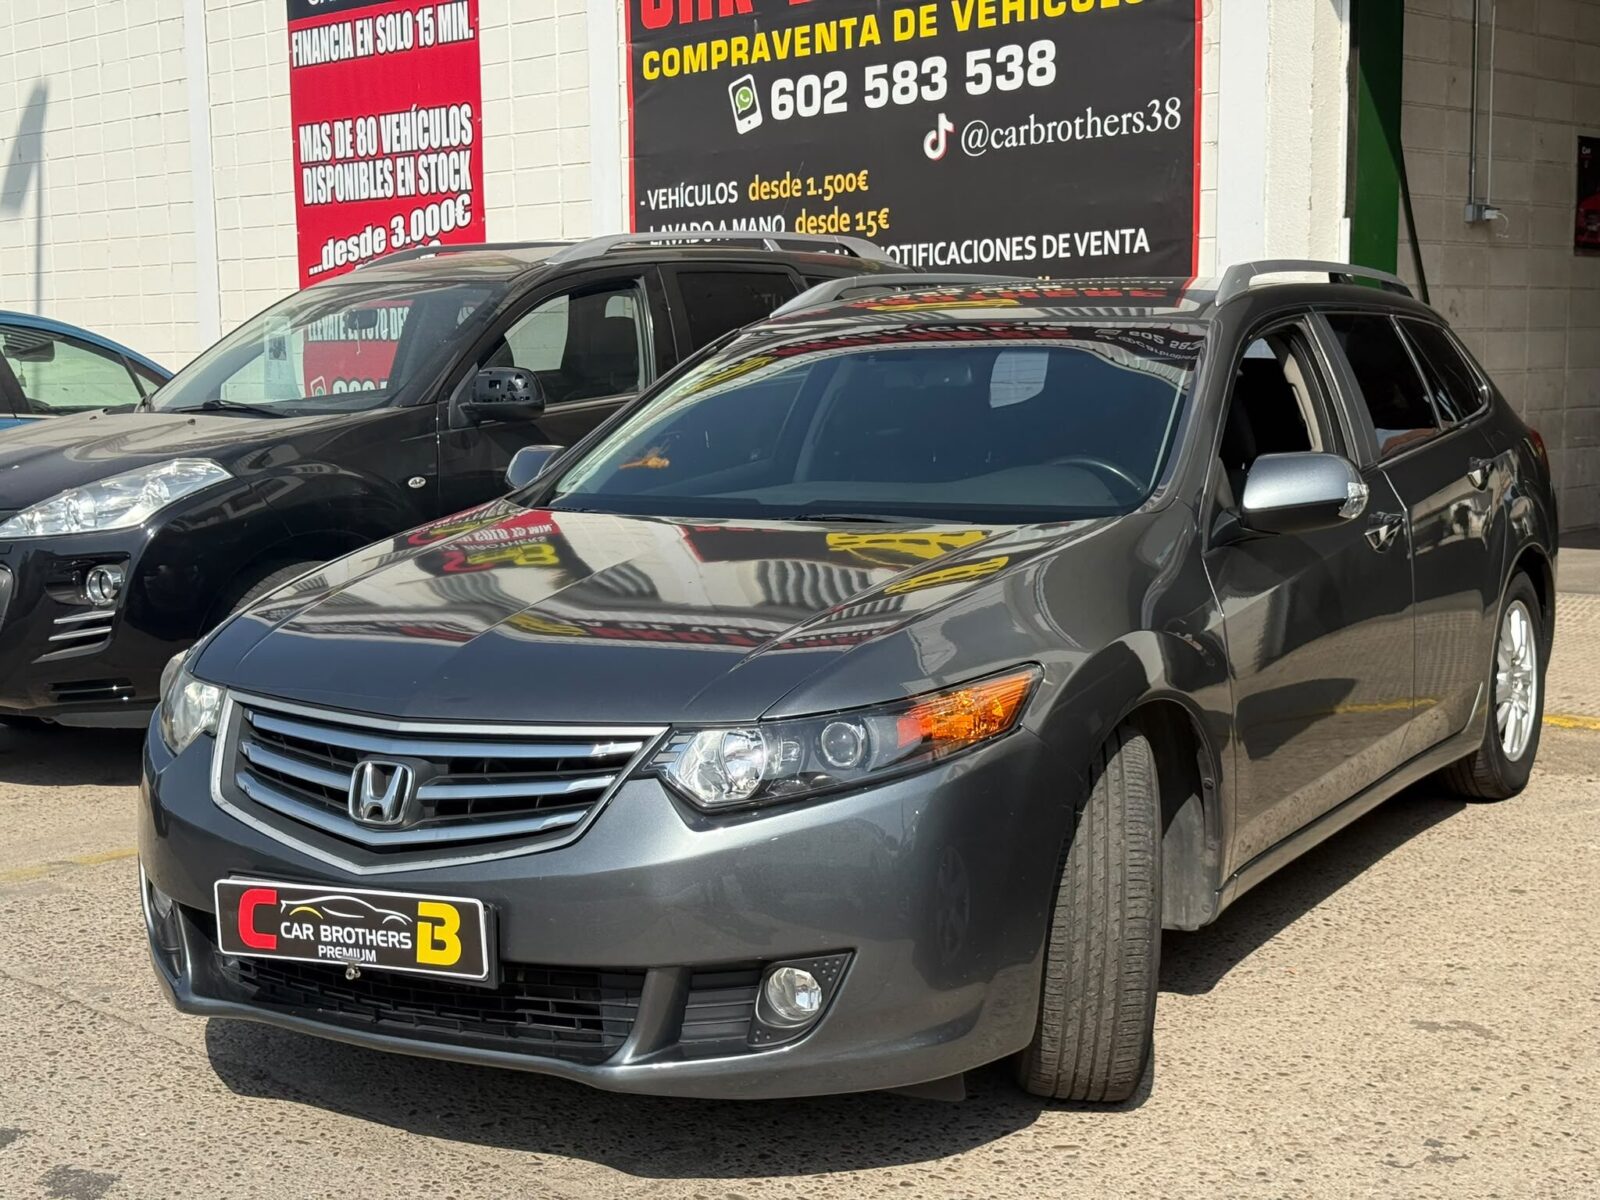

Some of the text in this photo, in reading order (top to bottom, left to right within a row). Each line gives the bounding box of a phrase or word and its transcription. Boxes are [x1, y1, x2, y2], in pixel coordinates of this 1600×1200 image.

[291, 1, 474, 68] FINANCIA EN SOLO 15 MIN.
[642, 14, 881, 80] COMPRAVENTA
[893, 3, 938, 42] DE
[771, 39, 1057, 120] 602 583 538
[299, 104, 473, 163] MAS DE 80 VEHÍCULOS
[961, 97, 1182, 157] @carbrothers38
[302, 150, 472, 205] DISPONIBLES EN STOCK
[749, 171, 802, 201] desde
[806, 170, 869, 201] 1.500€
[390, 193, 472, 249] 3.000€
[795, 206, 850, 234] desde
[855, 208, 890, 237] 15€
[1042, 233, 1071, 258] DE
[1074, 228, 1150, 256] VENTA
[238, 888, 278, 950] C
[280, 921, 412, 949] CAR BROTHERS
[416, 901, 462, 966] B
[318, 944, 377, 962] PREMIUM
